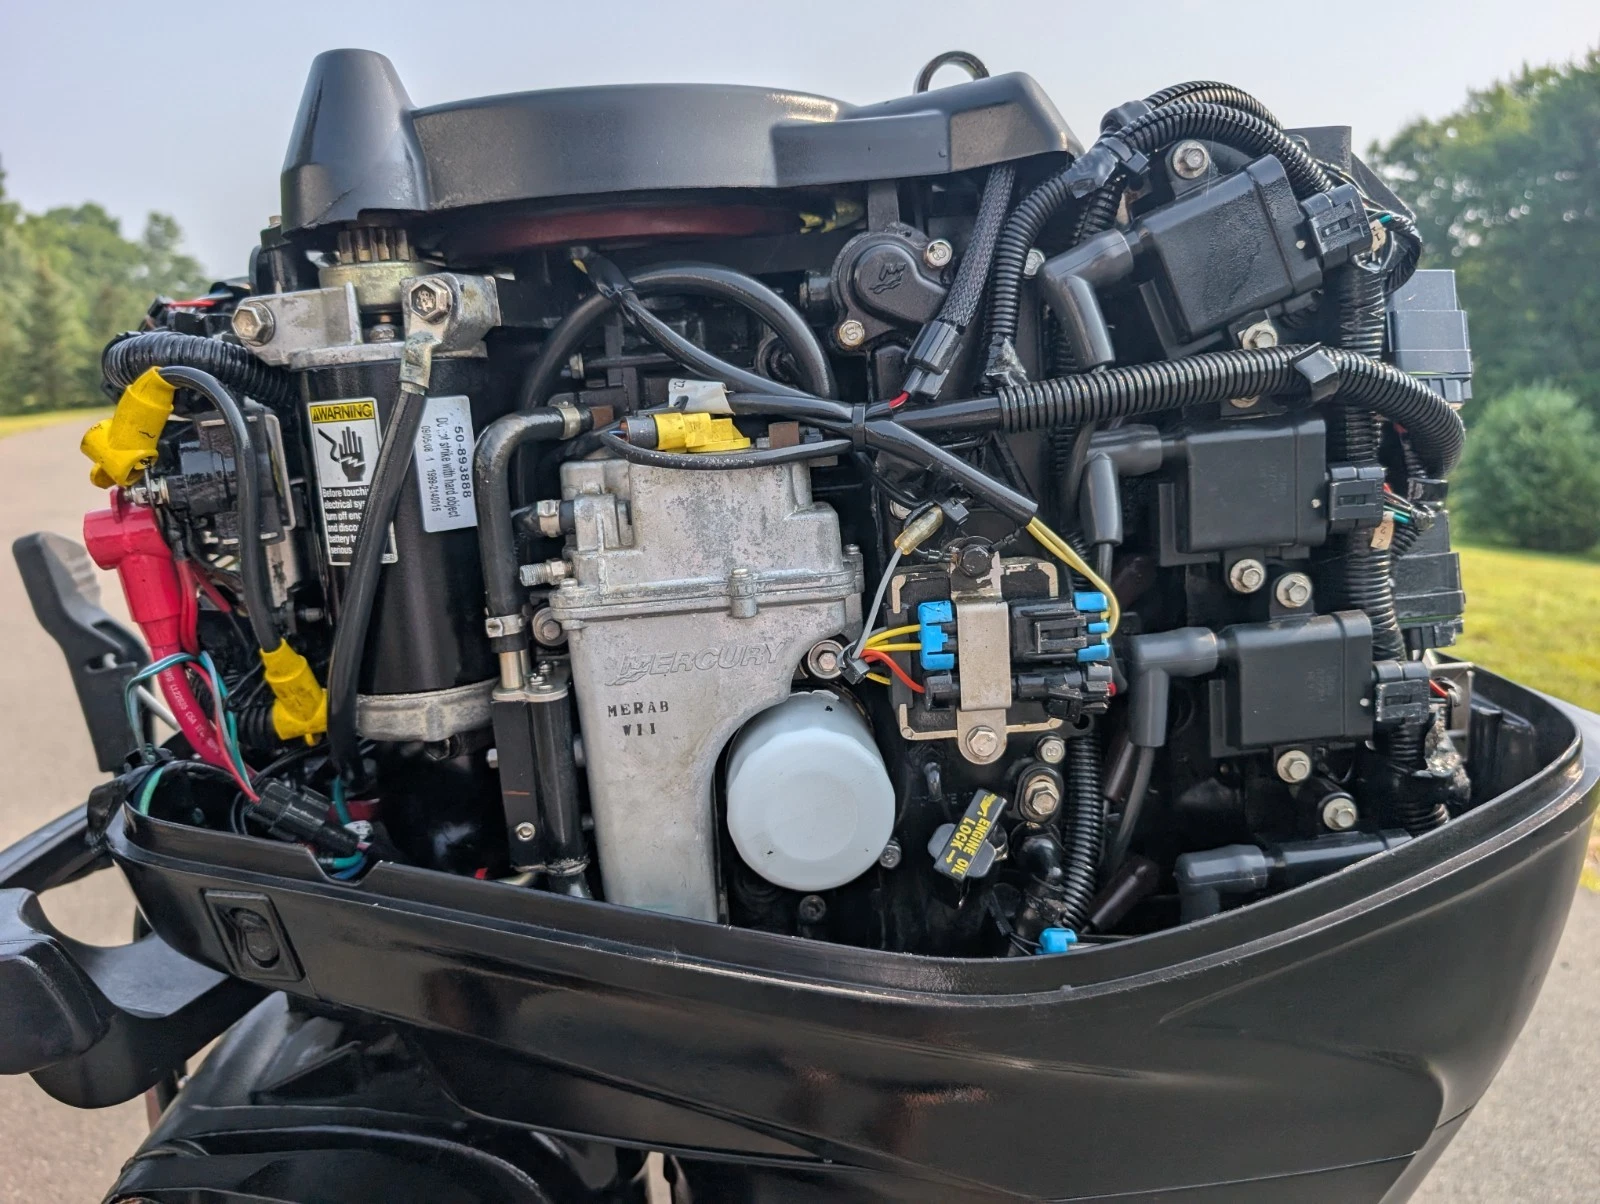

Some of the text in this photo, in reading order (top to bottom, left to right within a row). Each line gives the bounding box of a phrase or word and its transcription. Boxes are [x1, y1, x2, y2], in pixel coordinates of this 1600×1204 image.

[319, 403, 373, 420] WARNING
[438, 442, 454, 462] strike
[442, 462, 456, 478] with
[454, 425, 472, 498] 50-893888
[323, 486, 370, 498] Before touchi
[444, 478, 459, 496] hard
[324, 500, 352, 510] electrical
[444, 496, 461, 518] object
[326, 513, 337, 521] turn
[338, 511, 348, 522] off
[328, 522, 360, 533] and disco
[329, 534, 350, 546] battery
[330, 546, 353, 555] serious
[604, 641, 789, 686] MERCURY
[607, 700, 669, 718] MERAB
[950, 817, 976, 850] LOCK
[950, 818, 992, 875] ENGINE OIL
